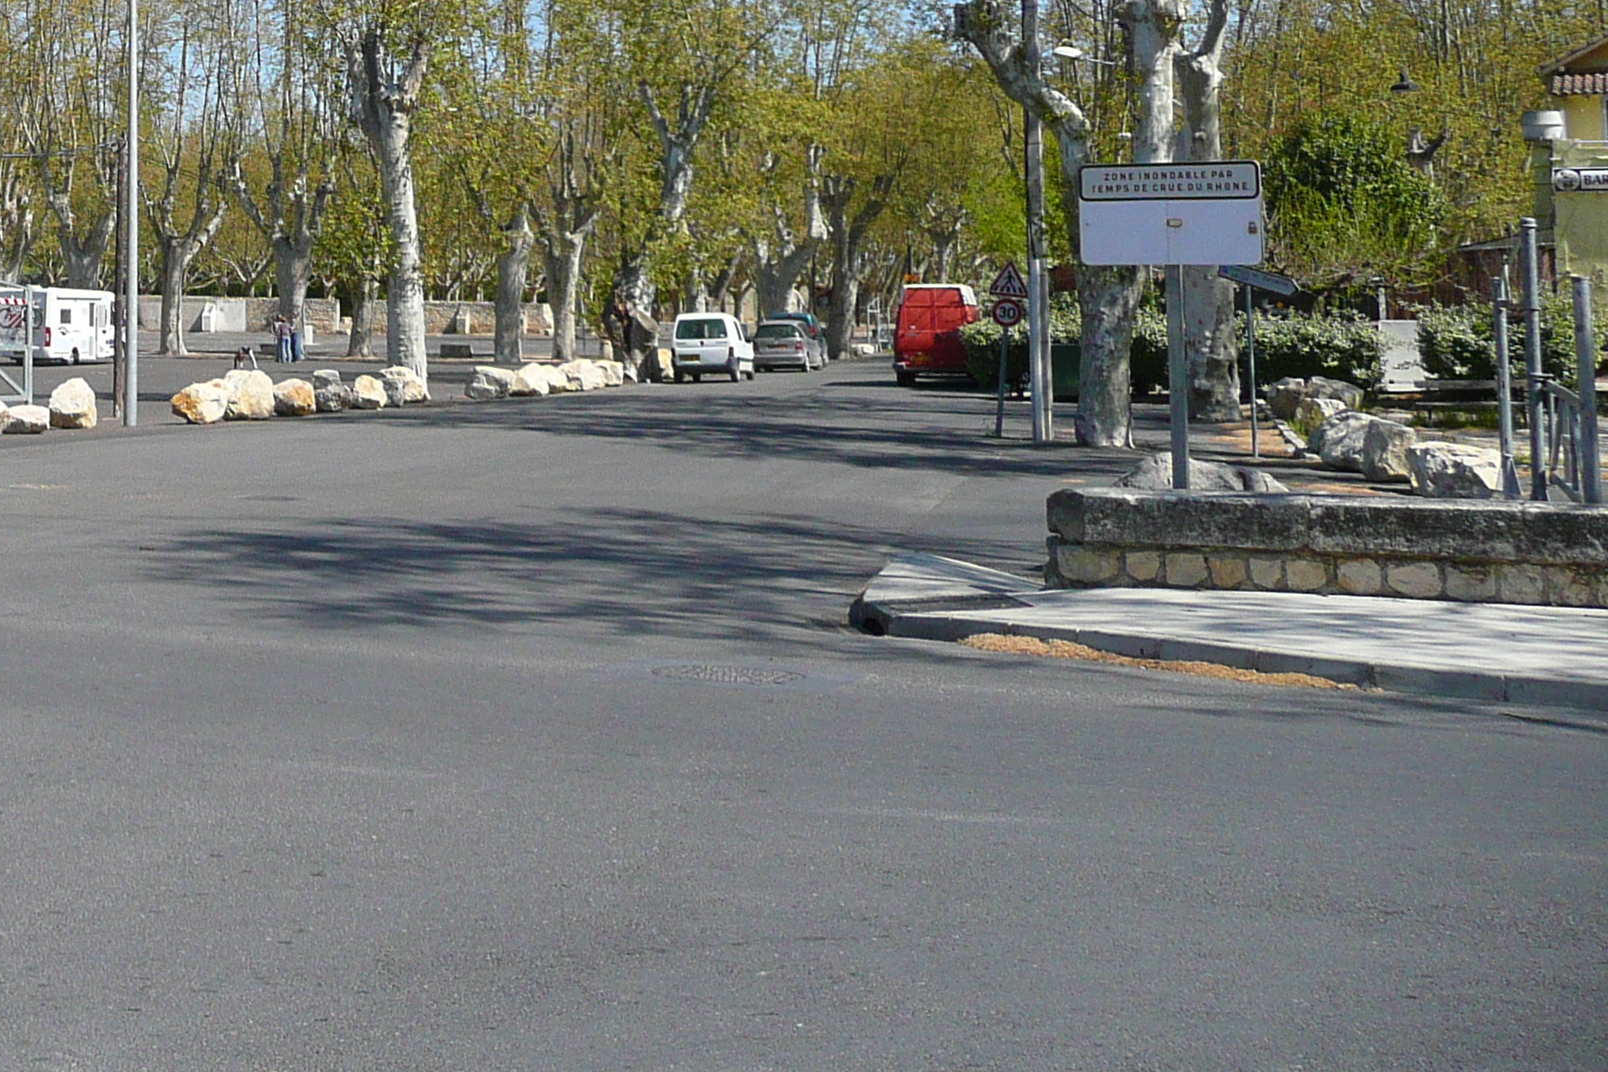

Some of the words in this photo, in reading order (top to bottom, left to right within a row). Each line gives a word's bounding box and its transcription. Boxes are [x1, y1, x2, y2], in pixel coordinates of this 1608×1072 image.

[1104, 172, 1134, 181] ZONE
[1138, 171, 1207, 181] INONDABLE
[1211, 170, 1233, 179] PAR
[1134, 184, 1148, 193] DE
[1152, 183, 1184, 192] CRUE
[1187, 182, 1203, 191] DU
[1207, 182, 1248, 191] RHONE
[998, 306, 1016, 319] 30
